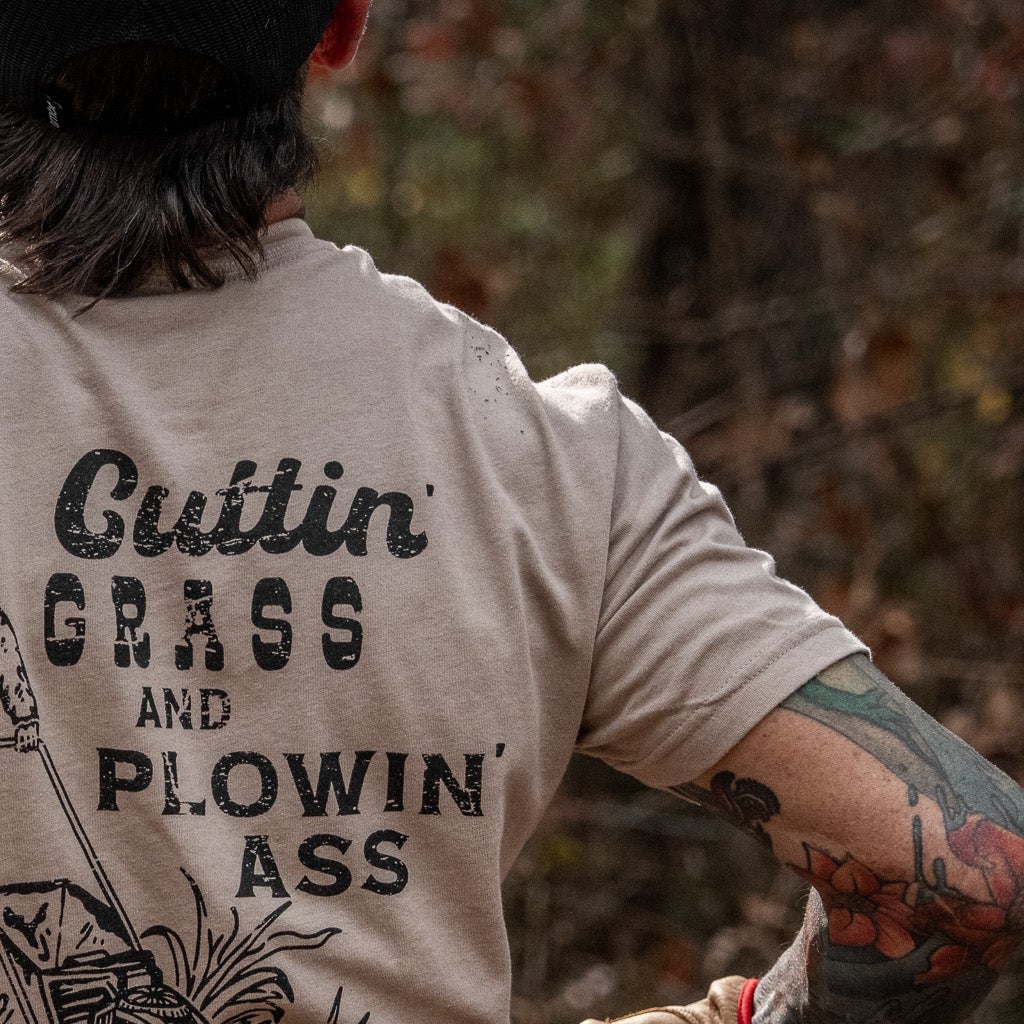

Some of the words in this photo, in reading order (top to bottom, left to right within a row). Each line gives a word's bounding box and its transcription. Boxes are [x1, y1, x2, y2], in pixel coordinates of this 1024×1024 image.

[54, 448, 435, 560] Cuttin'
[43, 573, 364, 671] GRASS
[135, 686, 232, 731] AND
[96, 743, 506, 817] PLOWIN'
[235, 829, 410, 898] ASS
